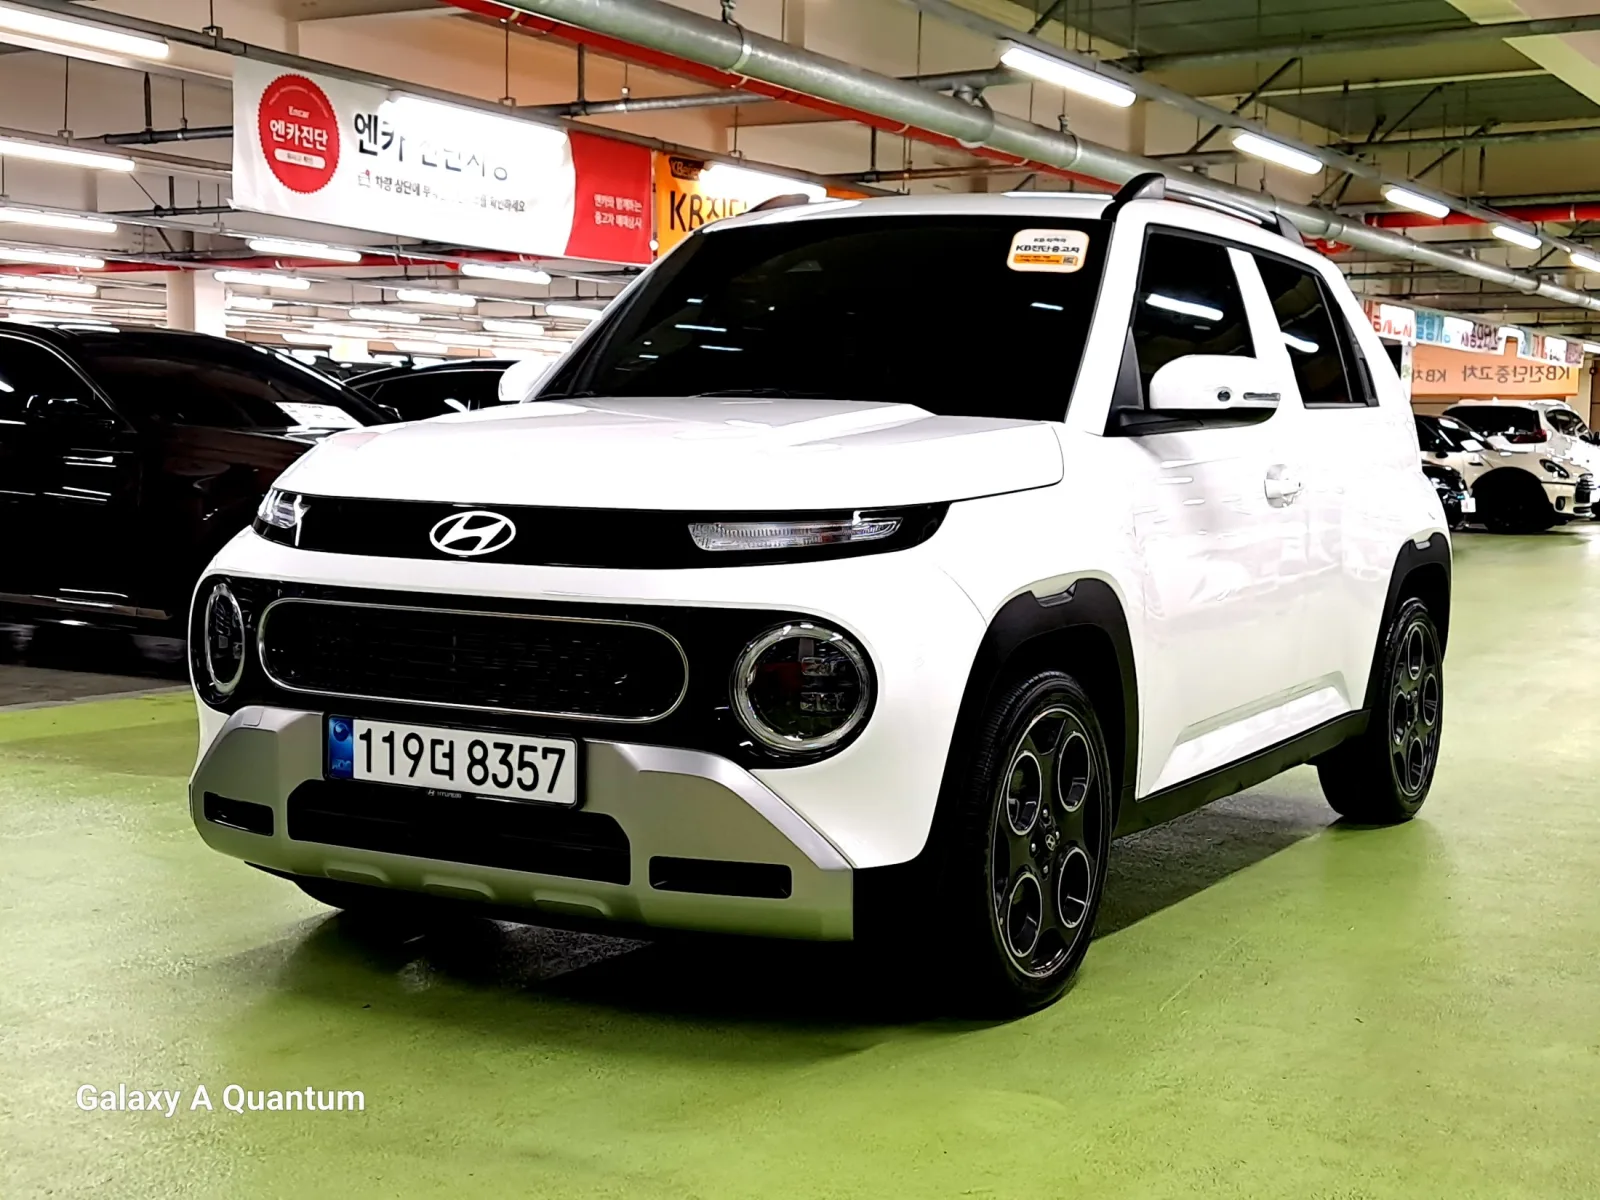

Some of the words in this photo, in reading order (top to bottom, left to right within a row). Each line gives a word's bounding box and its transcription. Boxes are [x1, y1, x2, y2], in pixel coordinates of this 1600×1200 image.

[269, 119, 329, 151] 엔카진단
[394, 179, 421, 196] 상단에
[594, 210, 615, 226] 중고차
[1015, 244, 1080, 253] KB진단중고차
[359, 728, 454, 781] 119더
[467, 739, 566, 794] 8357
